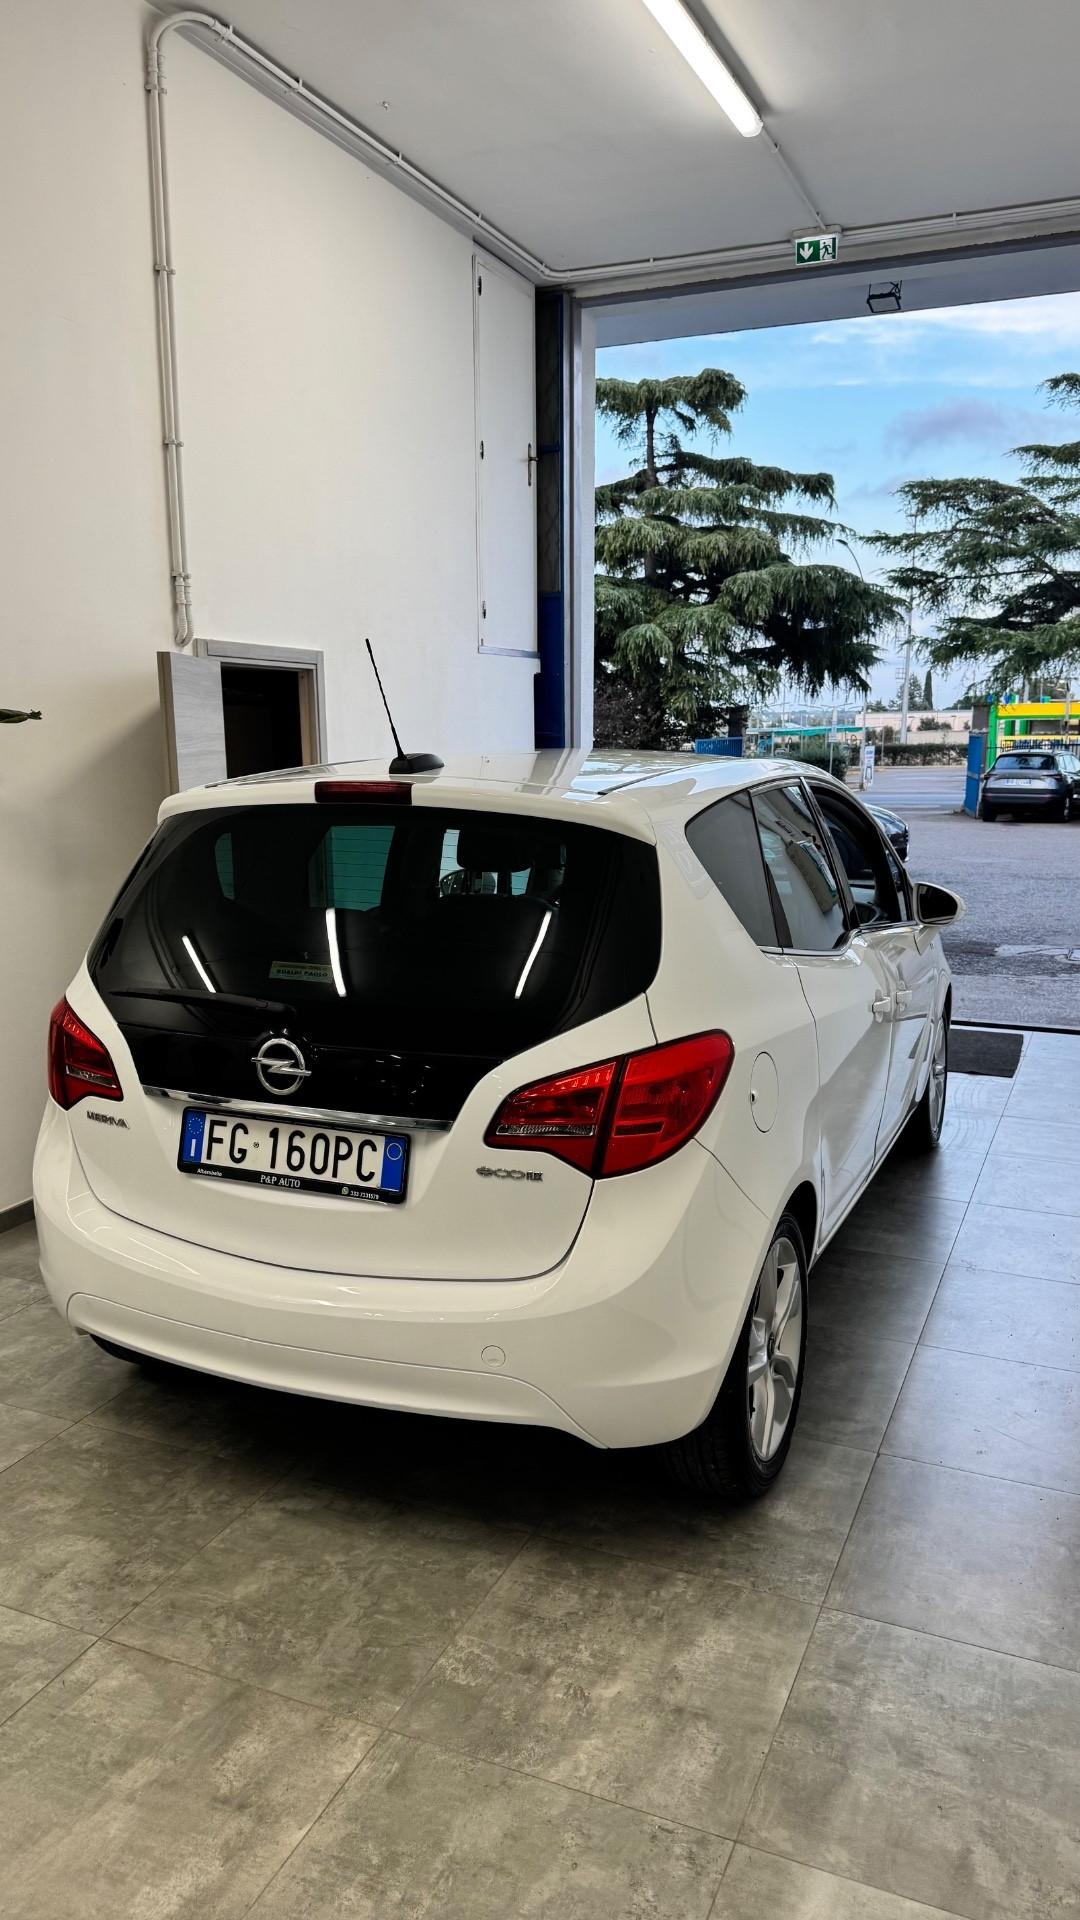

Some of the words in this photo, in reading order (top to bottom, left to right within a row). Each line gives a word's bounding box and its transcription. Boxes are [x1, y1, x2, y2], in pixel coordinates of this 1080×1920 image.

[206, 1119, 249, 1164] FG
[269, 1127, 378, 1182] 160PC
[260, 1174, 277, 1185] P&P
[279, 1177, 301, 1188] AUTO
